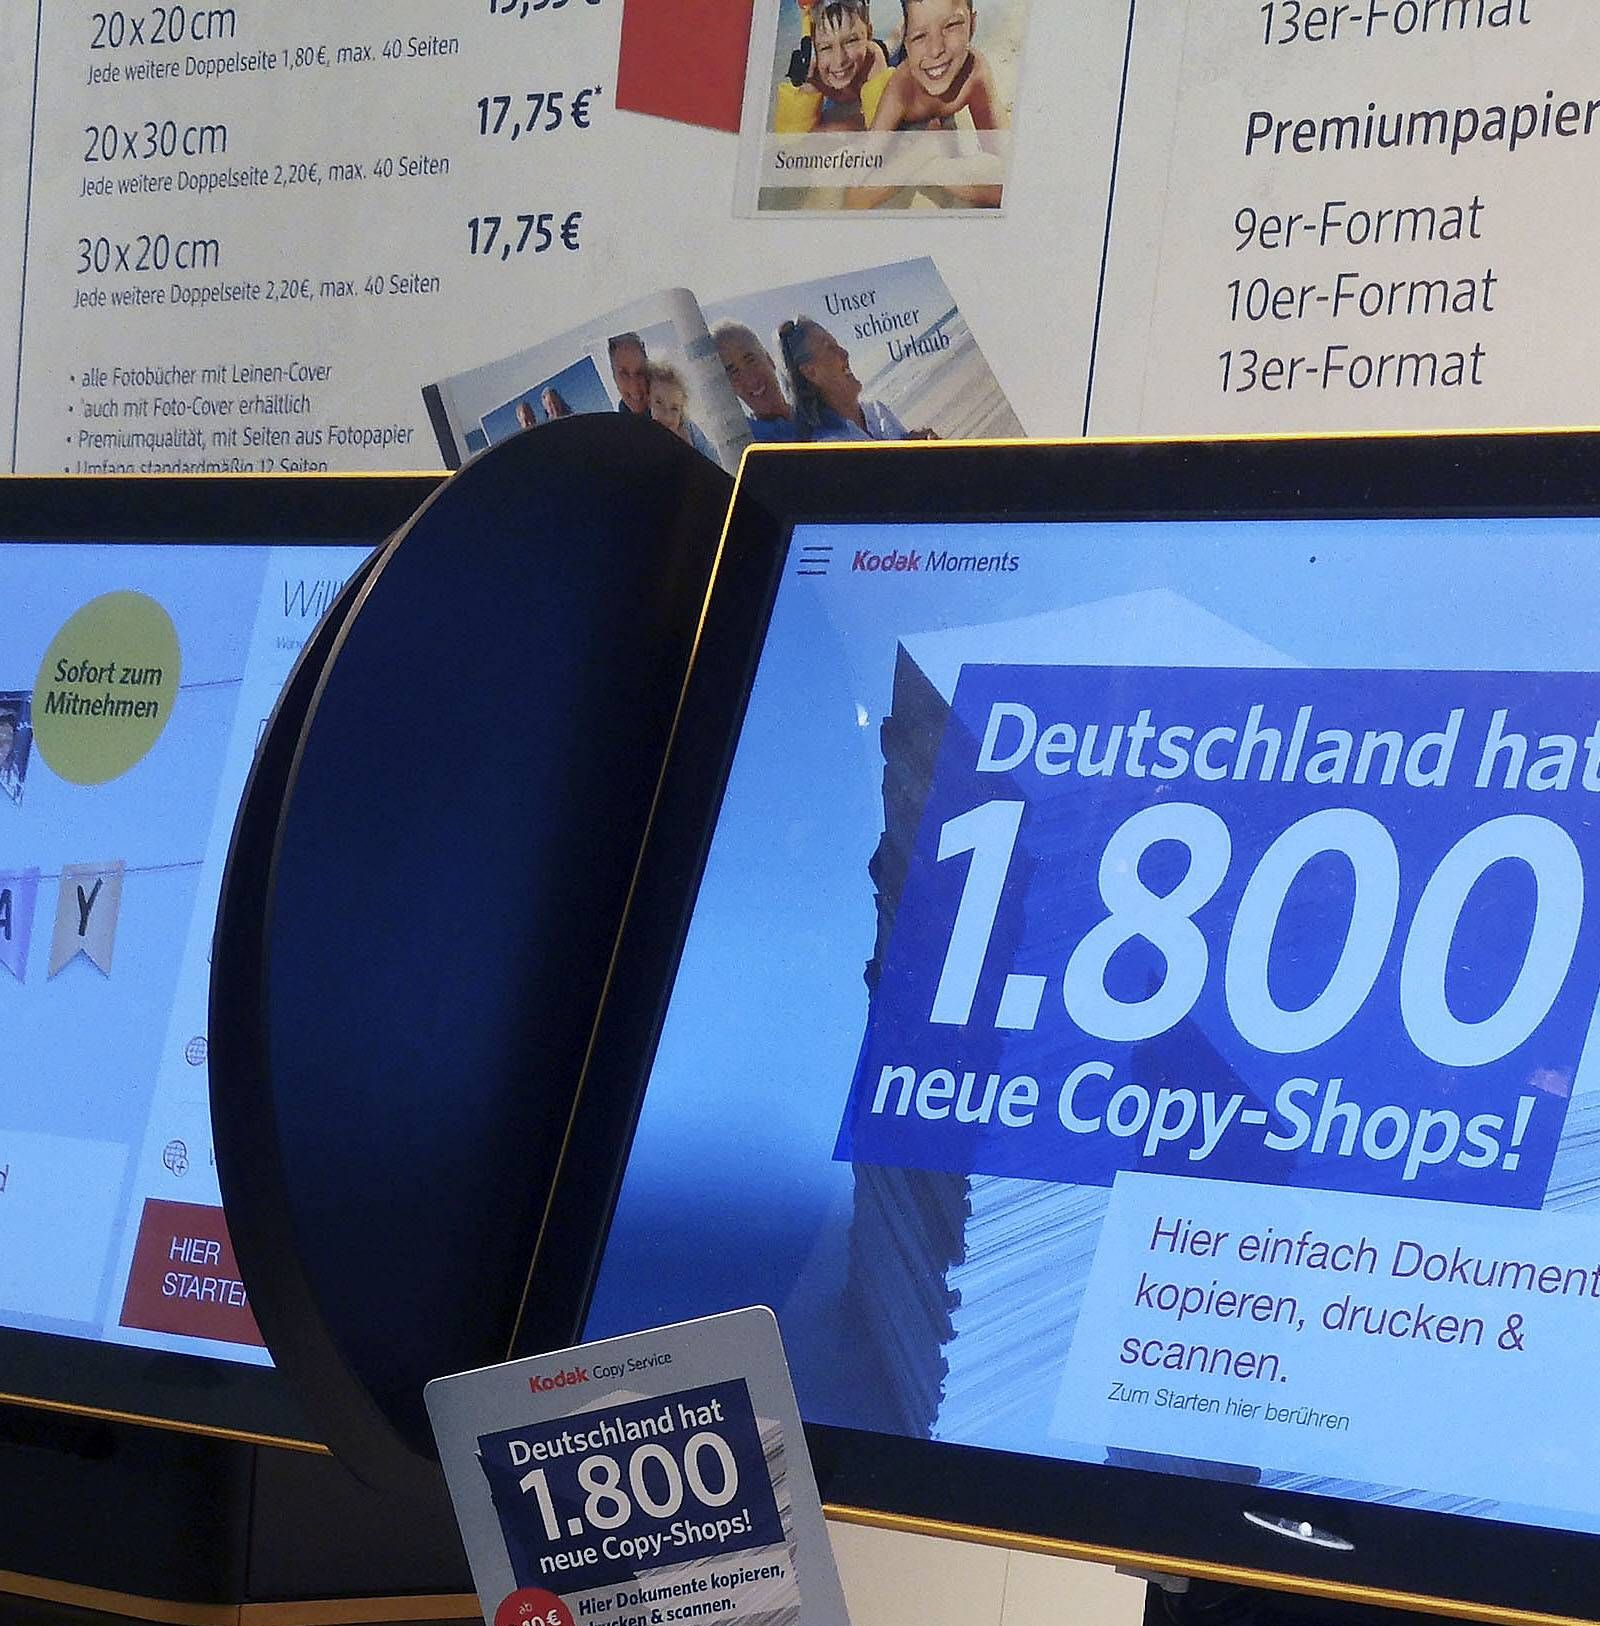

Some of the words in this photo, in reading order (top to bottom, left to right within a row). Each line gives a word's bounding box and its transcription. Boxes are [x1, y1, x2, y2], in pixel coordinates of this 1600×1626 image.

[87, 65, 119, 85] Jede
[126, 59, 179, 79] weitere
[185, 50, 276, 77] Doppelseite
[336, 42, 376, 62] max.
[382, 39, 402, 59] 40
[406, 34, 458, 57] Seiten
[775, 150, 883, 171] Sommerferien
[1234, 197, 1484, 251] 9er-Format
[825, 288, 876, 316] Unser
[1227, 269, 1497, 322] 10er-Format
[854, 306, 920, 339] schöner
[886, 328, 950, 362] Urlaub
[82, 368, 108, 388] alle
[113, 364, 197, 387] Fotobücher
[202, 364, 226, 383] mit
[232, 361, 331, 383] Leinen-Cover
[1219, 342, 1486, 394] 13er-Format
[79, 428, 207, 453] Premiumqualität,
[212, 428, 237, 447] mit
[242, 426, 290, 446] Seiten
[295, 429, 323, 444] aus
[328, 425, 413, 448] Fotopapier
[851, 548, 921, 575] Kodak
[925, 549, 1020, 575] Moments
[54, 657, 114, 687] Sofort
[120, 663, 163, 686] zum
[45, 692, 159, 720] Mitnehmen
[975, 702, 1466, 792] Deutschland
[928, 799, 1586, 1068] 1.800
[871, 1062, 1038, 1129] neue
[1058, 1062, 1541, 1180] Copy-Shops!
[169, 1236, 220, 1266] HIER
[1149, 1218, 1229, 1258] Hier
[1238, 1224, 1378, 1275] einfach
[1136, 1275, 1306, 1330] kopieren,
[1322, 1295, 1485, 1347] drucken
[1497, 1312, 1525, 1351] &
[528, 1368, 590, 1392] Kodak
[593, 1362, 625, 1382] Copy
[627, 1352, 672, 1373] Service
[1119, 1332, 1288, 1384] scannen.
[1108, 1382, 1150, 1406] Zum
[1154, 1389, 1221, 1416] Starten
[1226, 1397, 1261, 1420] hier
[1265, 1400, 1350, 1431] berühren
[509, 1409, 674, 1467] Deutschland
[678, 1399, 723, 1430] hat
[519, 1432, 738, 1541] 1.800
[539, 1541, 598, 1575] neue
[602, 1510, 752, 1565] Copy-Shops!
[579, 1596, 613, 1617] Hier
[616, 1579, 708, 1608] Dokumente
[711, 1564, 785, 1592] kopieren,
[650, 1608, 662, 1624] &
[666, 1598, 736, 1624] scannen.
